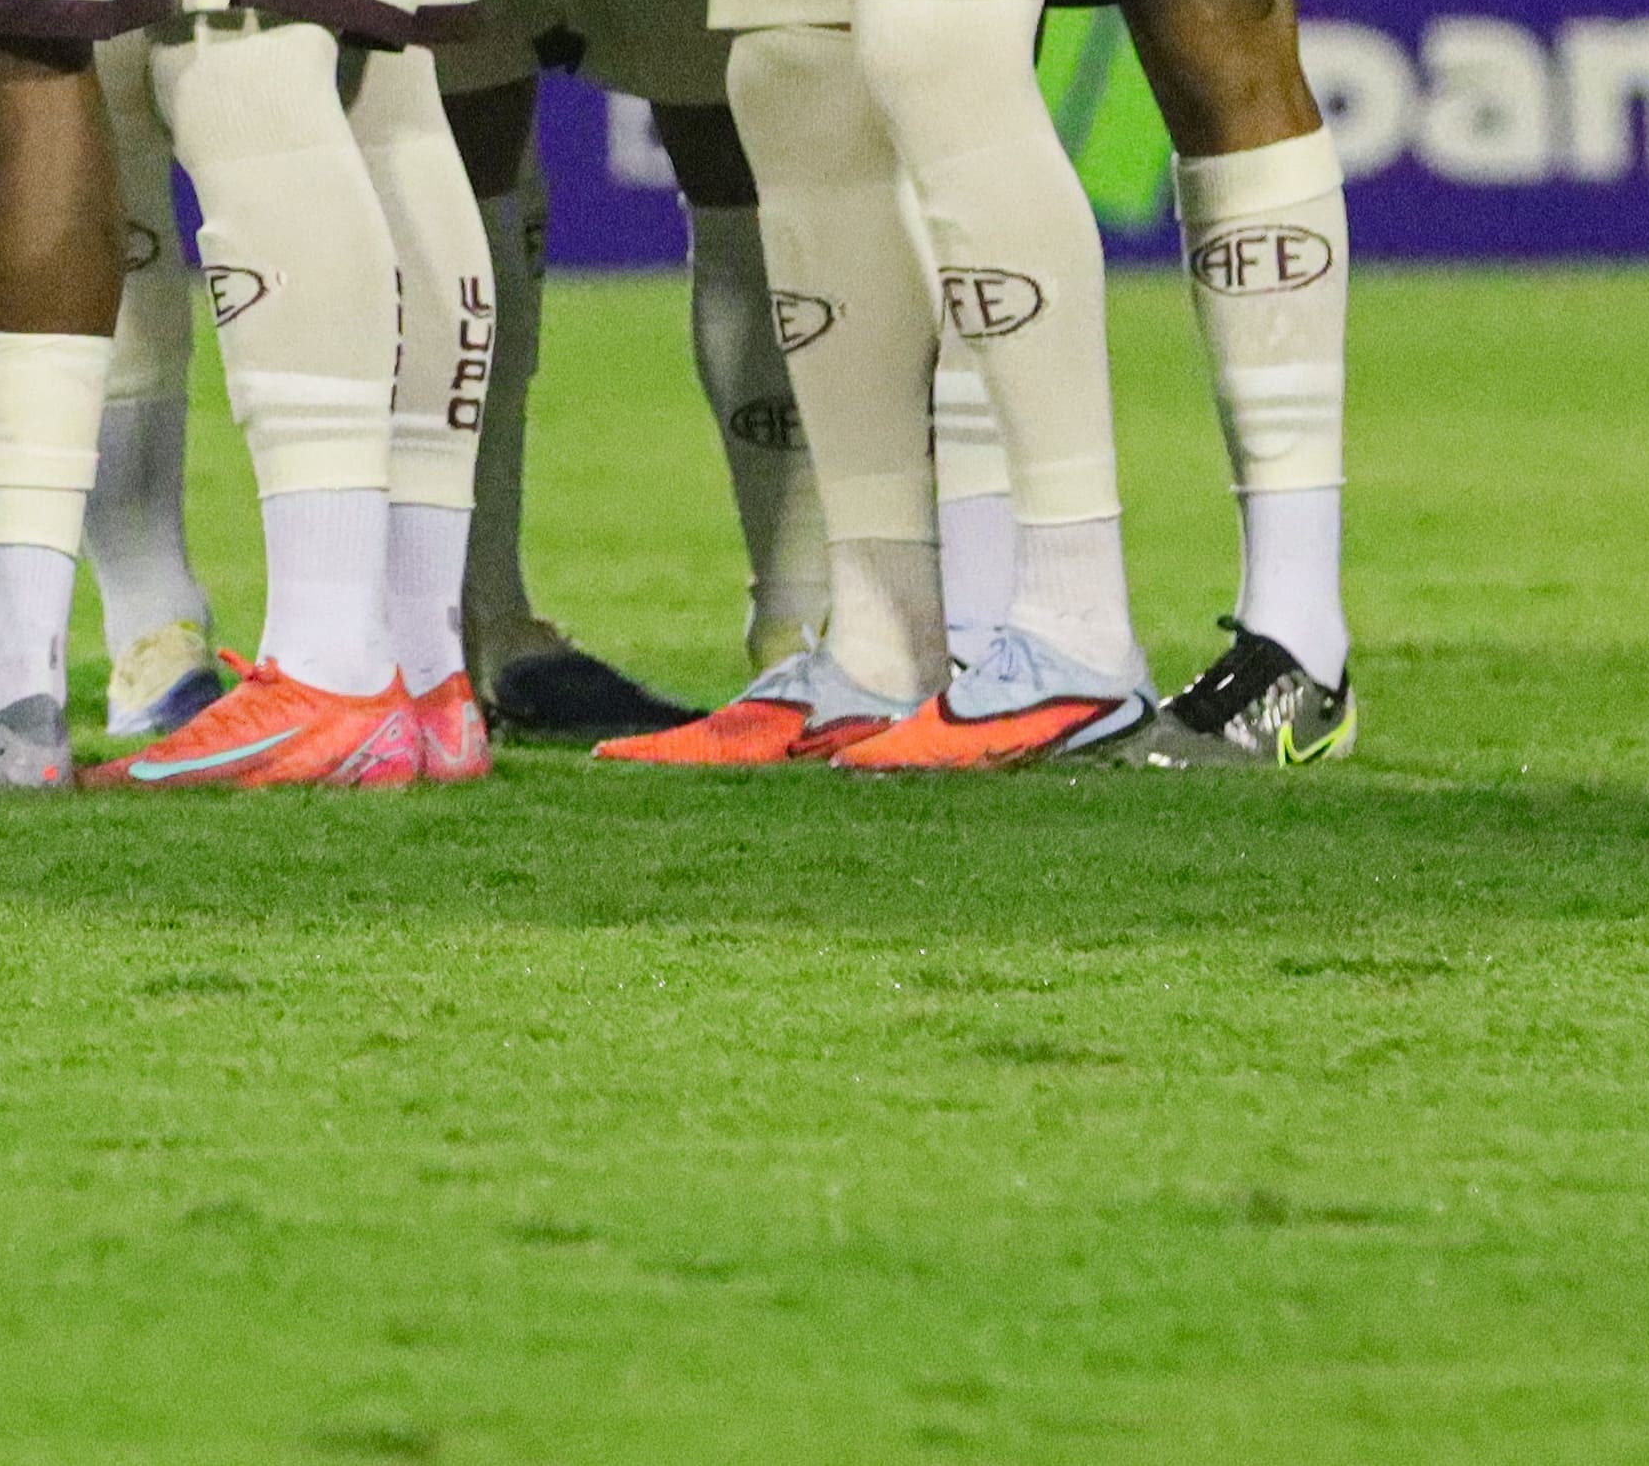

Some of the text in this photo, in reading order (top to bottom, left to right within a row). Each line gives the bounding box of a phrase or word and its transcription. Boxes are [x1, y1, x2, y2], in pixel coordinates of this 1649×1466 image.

[1203, 234, 1310, 288] AFE
[942, 276, 1018, 330] FE
[447, 275, 494, 433] LUPO
